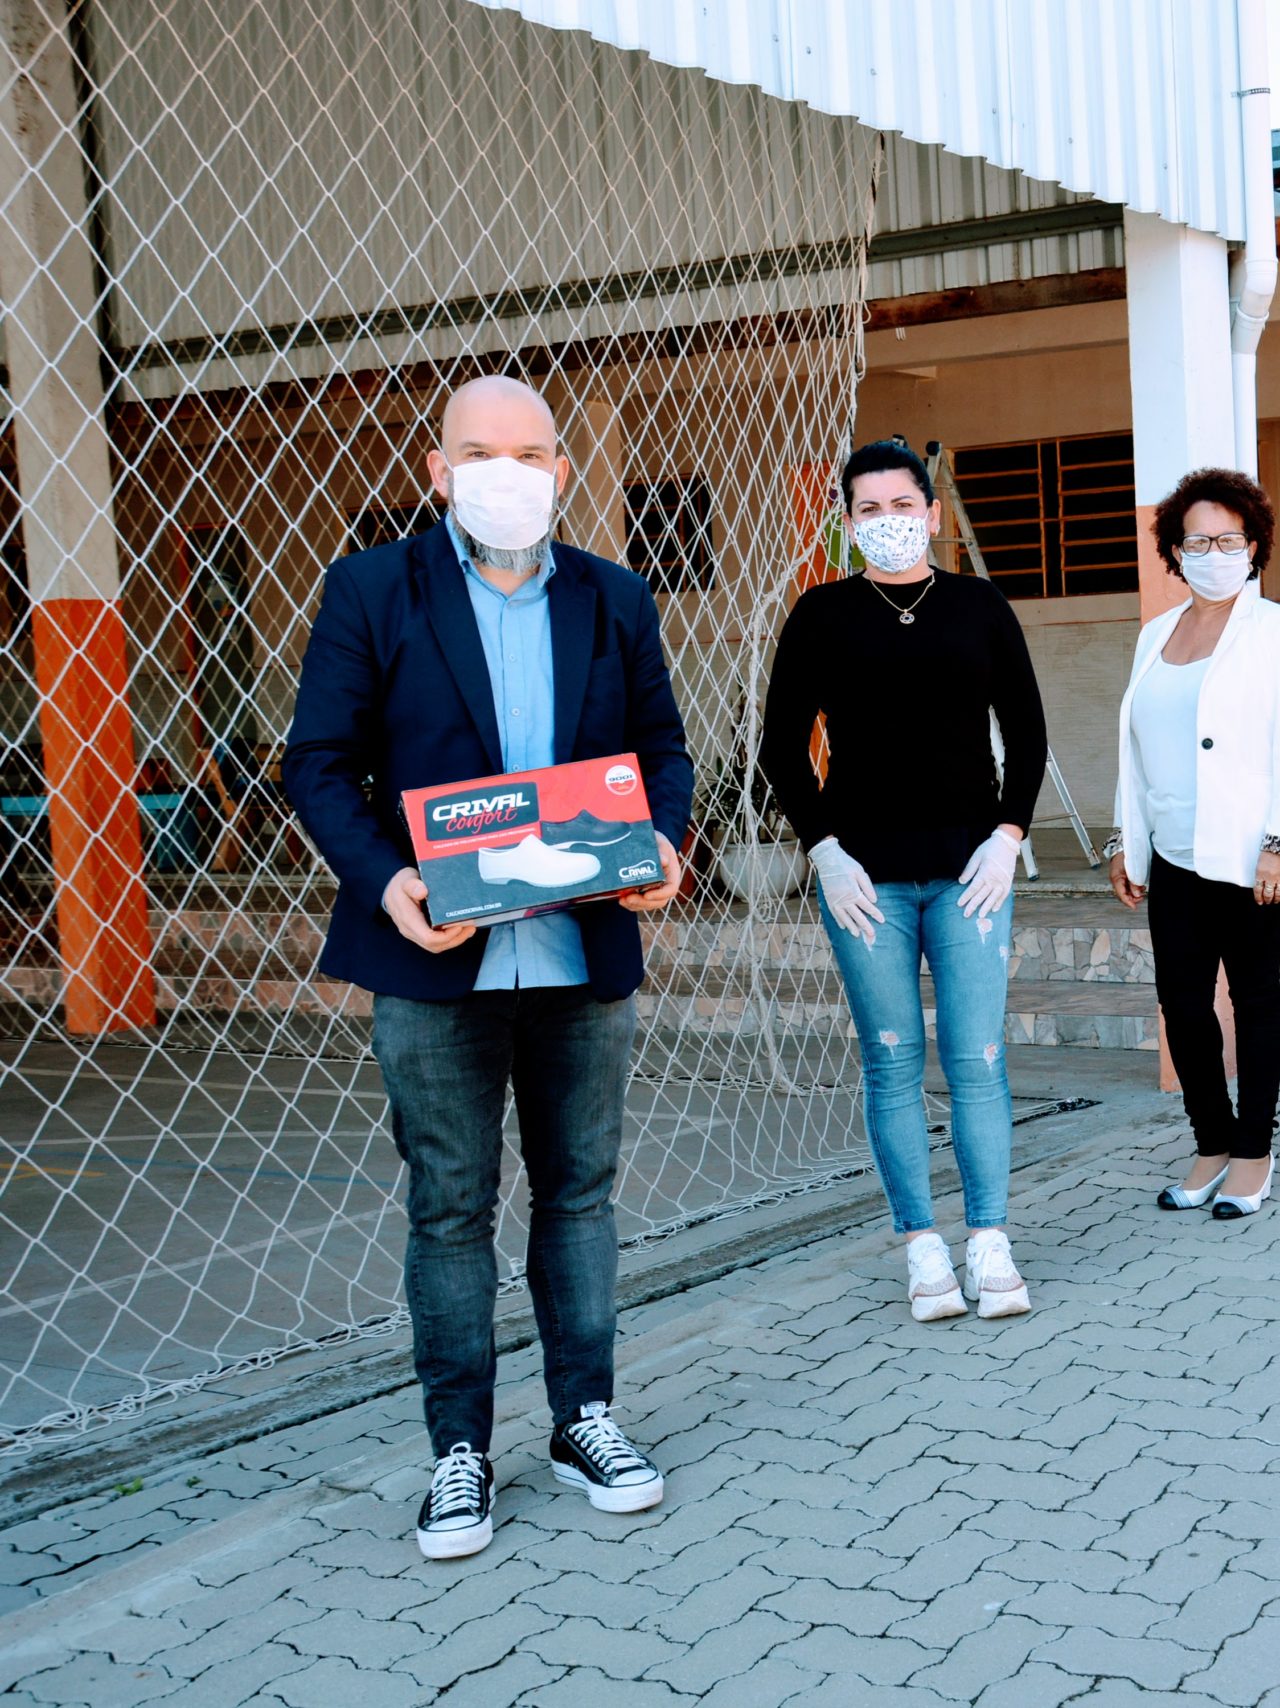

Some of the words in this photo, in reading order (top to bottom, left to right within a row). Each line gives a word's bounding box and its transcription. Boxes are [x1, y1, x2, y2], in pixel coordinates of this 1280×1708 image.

[608, 774, 633, 782] 9001
[433, 792, 530, 821] CRIVAL
[446, 807, 518, 834] confort
[619, 865, 656, 879] CRIVAL
